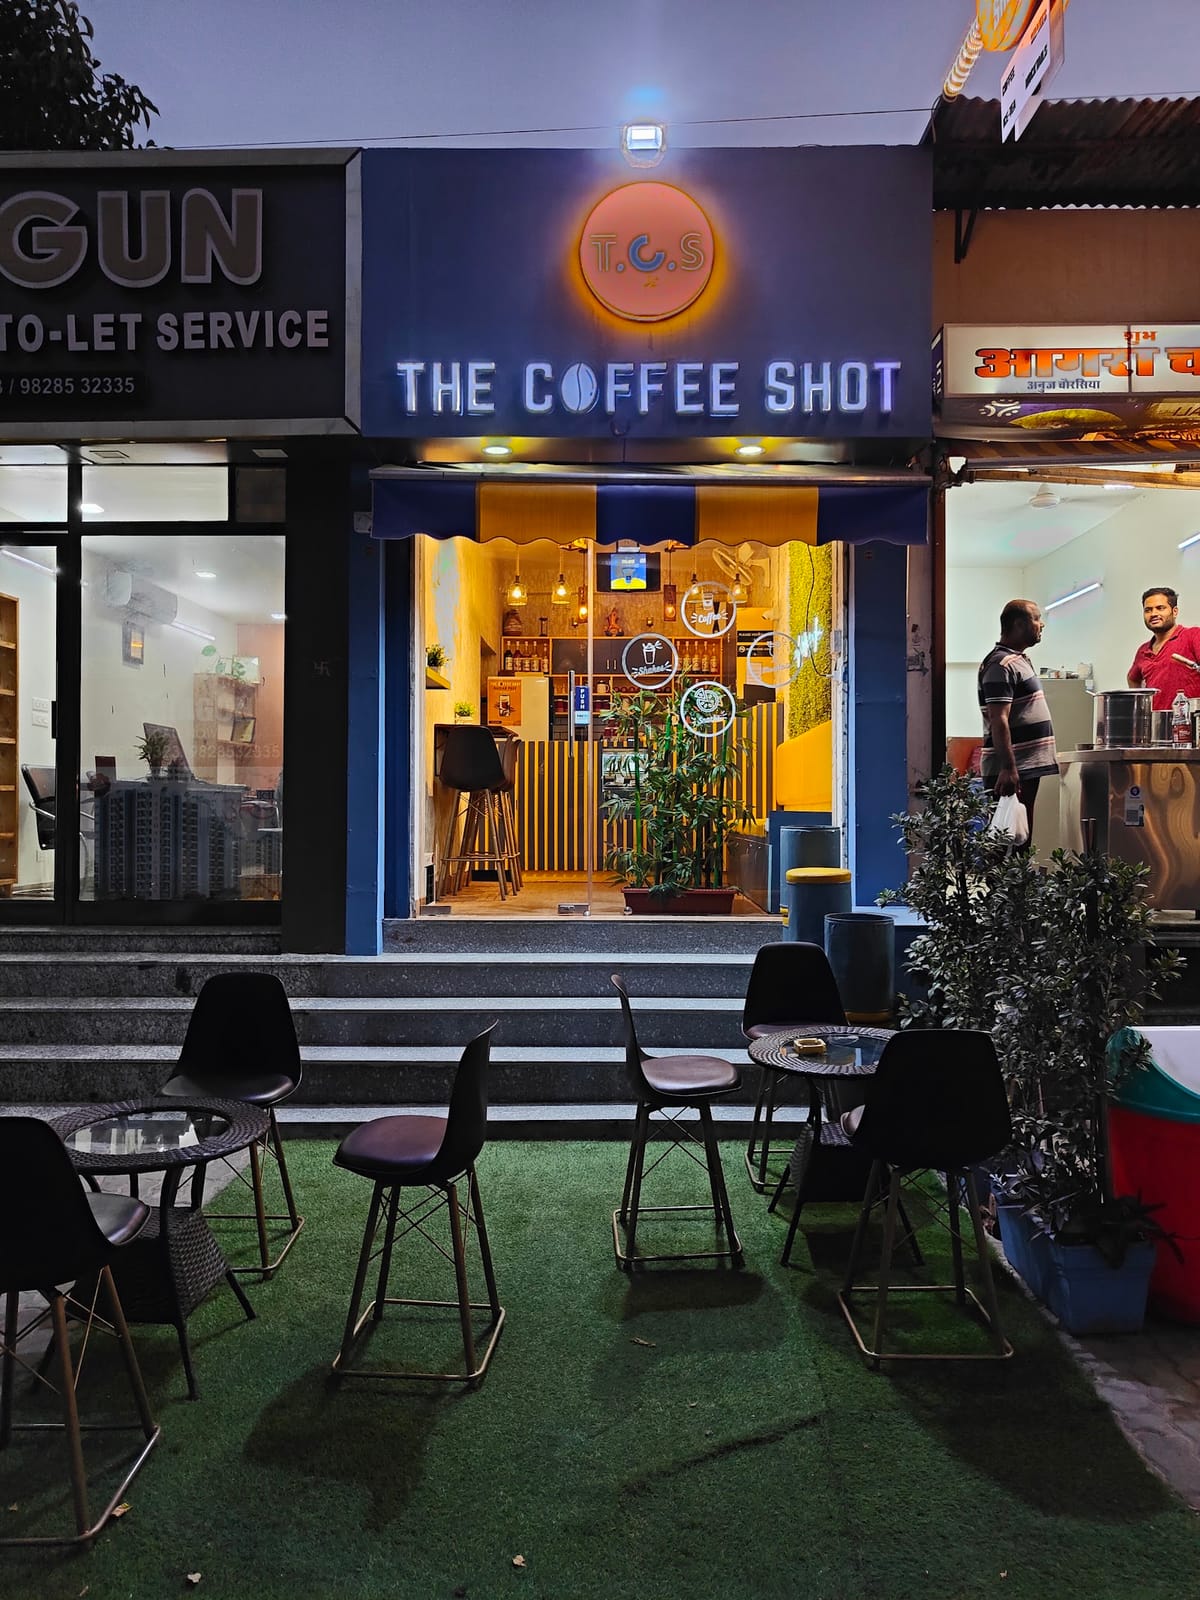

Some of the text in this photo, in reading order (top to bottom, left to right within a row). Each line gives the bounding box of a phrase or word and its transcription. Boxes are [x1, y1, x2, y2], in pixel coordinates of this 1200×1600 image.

[0, 188, 263, 289] GUN
[156, 310, 329, 350] SERVICE
[20, 378, 75, 394] 98285
[81, 377, 135, 393] 32335
[396, 362, 496, 415] THE
[524, 362, 740, 415] COFFEE
[766, 361, 902, 414] SHOT
[698, 612, 721, 624] Coffee
[639, 664, 666, 675] Shakes
